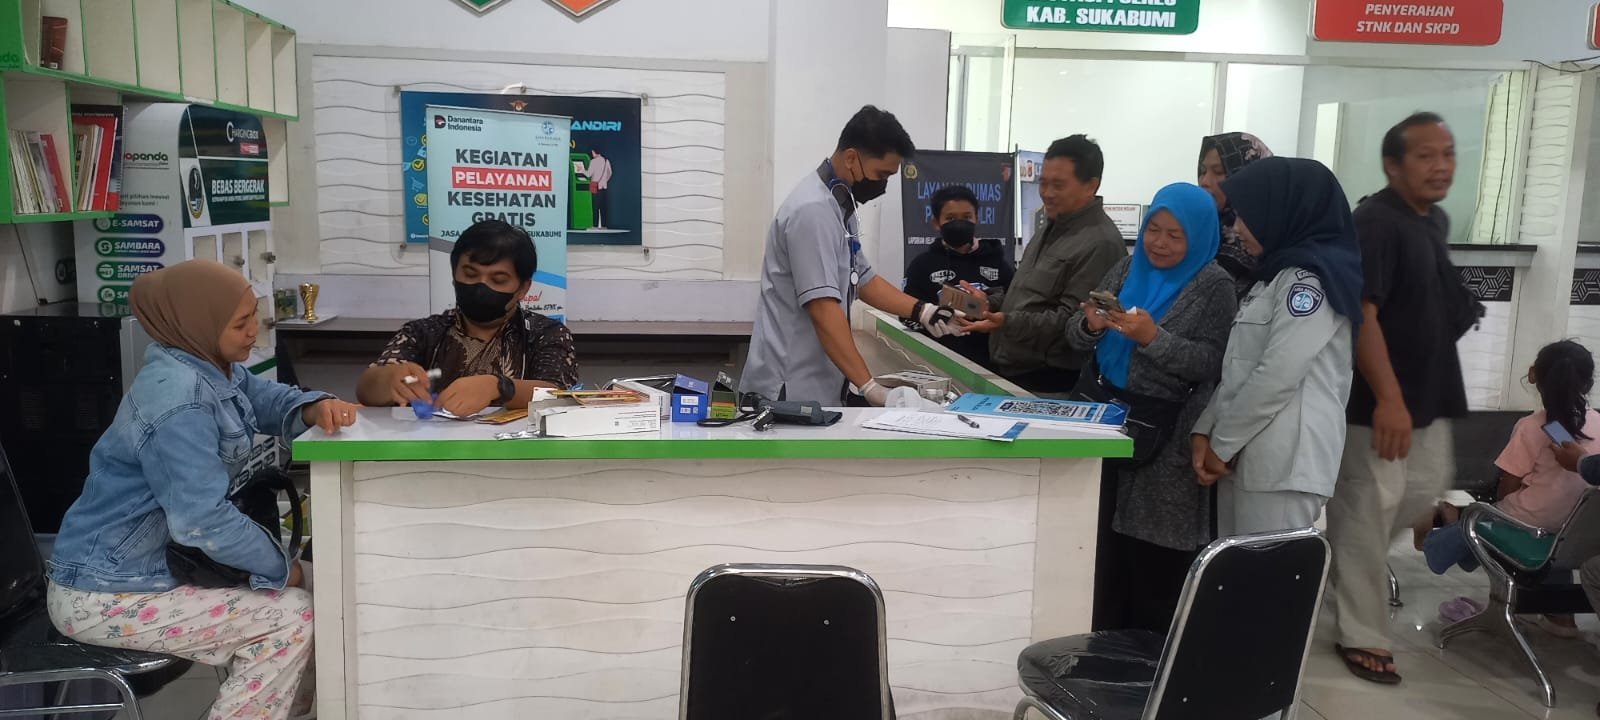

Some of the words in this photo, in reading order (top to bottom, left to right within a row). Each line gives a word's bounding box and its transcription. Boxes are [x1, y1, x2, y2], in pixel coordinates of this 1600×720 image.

[1026, 5, 1070, 24] KAB.
[1076, 7, 1176, 28] SUKABUMI
[1365, 3, 1455, 17] PENYERAHAN
[1356, 21, 1392, 33] STNK
[1394, 21, 1423, 34] DAN
[1425, 22, 1460, 35] SKPD
[447, 115, 484, 125] Danantara
[570, 120, 622, 132] ANDIRI
[447, 123, 482, 132] Indonesia
[124, 151, 169, 162] apenda
[455, 148, 548, 168] KEGIATAN
[455, 171, 550, 187] PELAYANAN
[211, 179, 233, 195] BEBAS
[234, 179, 265, 194] BERGERAK
[447, 190, 556, 208] KESEHATAN
[978, 206, 995, 225] LRI
[112, 219, 160, 228] E-SAMSAT
[440, 230, 460, 238] JASA
[114, 241, 160, 250] SAMBARA
[117, 264, 160, 273] SAMSAT
